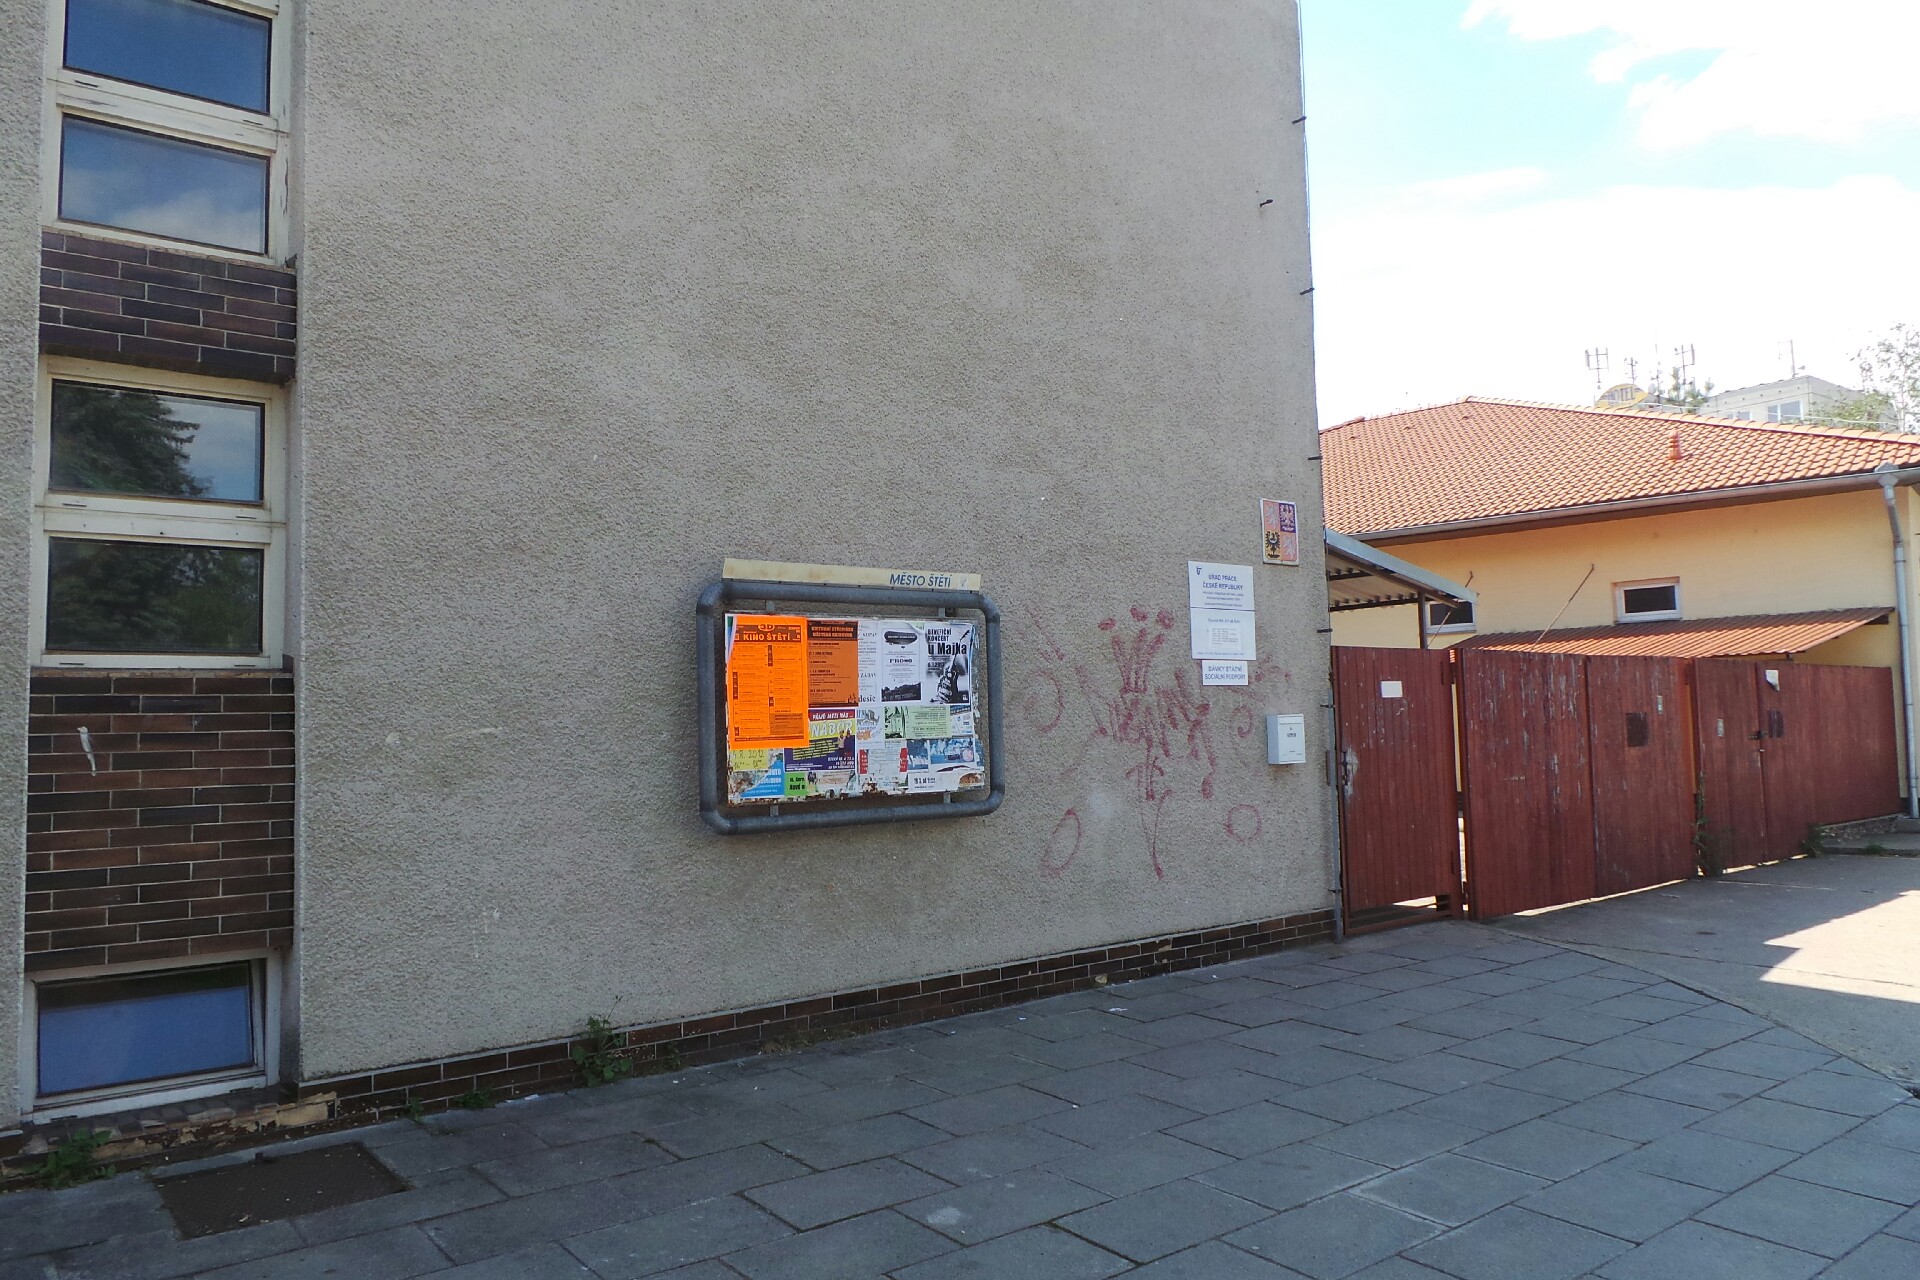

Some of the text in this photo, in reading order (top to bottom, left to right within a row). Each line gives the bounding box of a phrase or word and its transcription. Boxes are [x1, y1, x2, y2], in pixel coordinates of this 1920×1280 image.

[889, 571, 952, 588] MĚSTO ŠTĚTÍ
[766, 632, 790, 640] ŠTĚTÍ
[811, 720, 853, 737] NÁBOR
